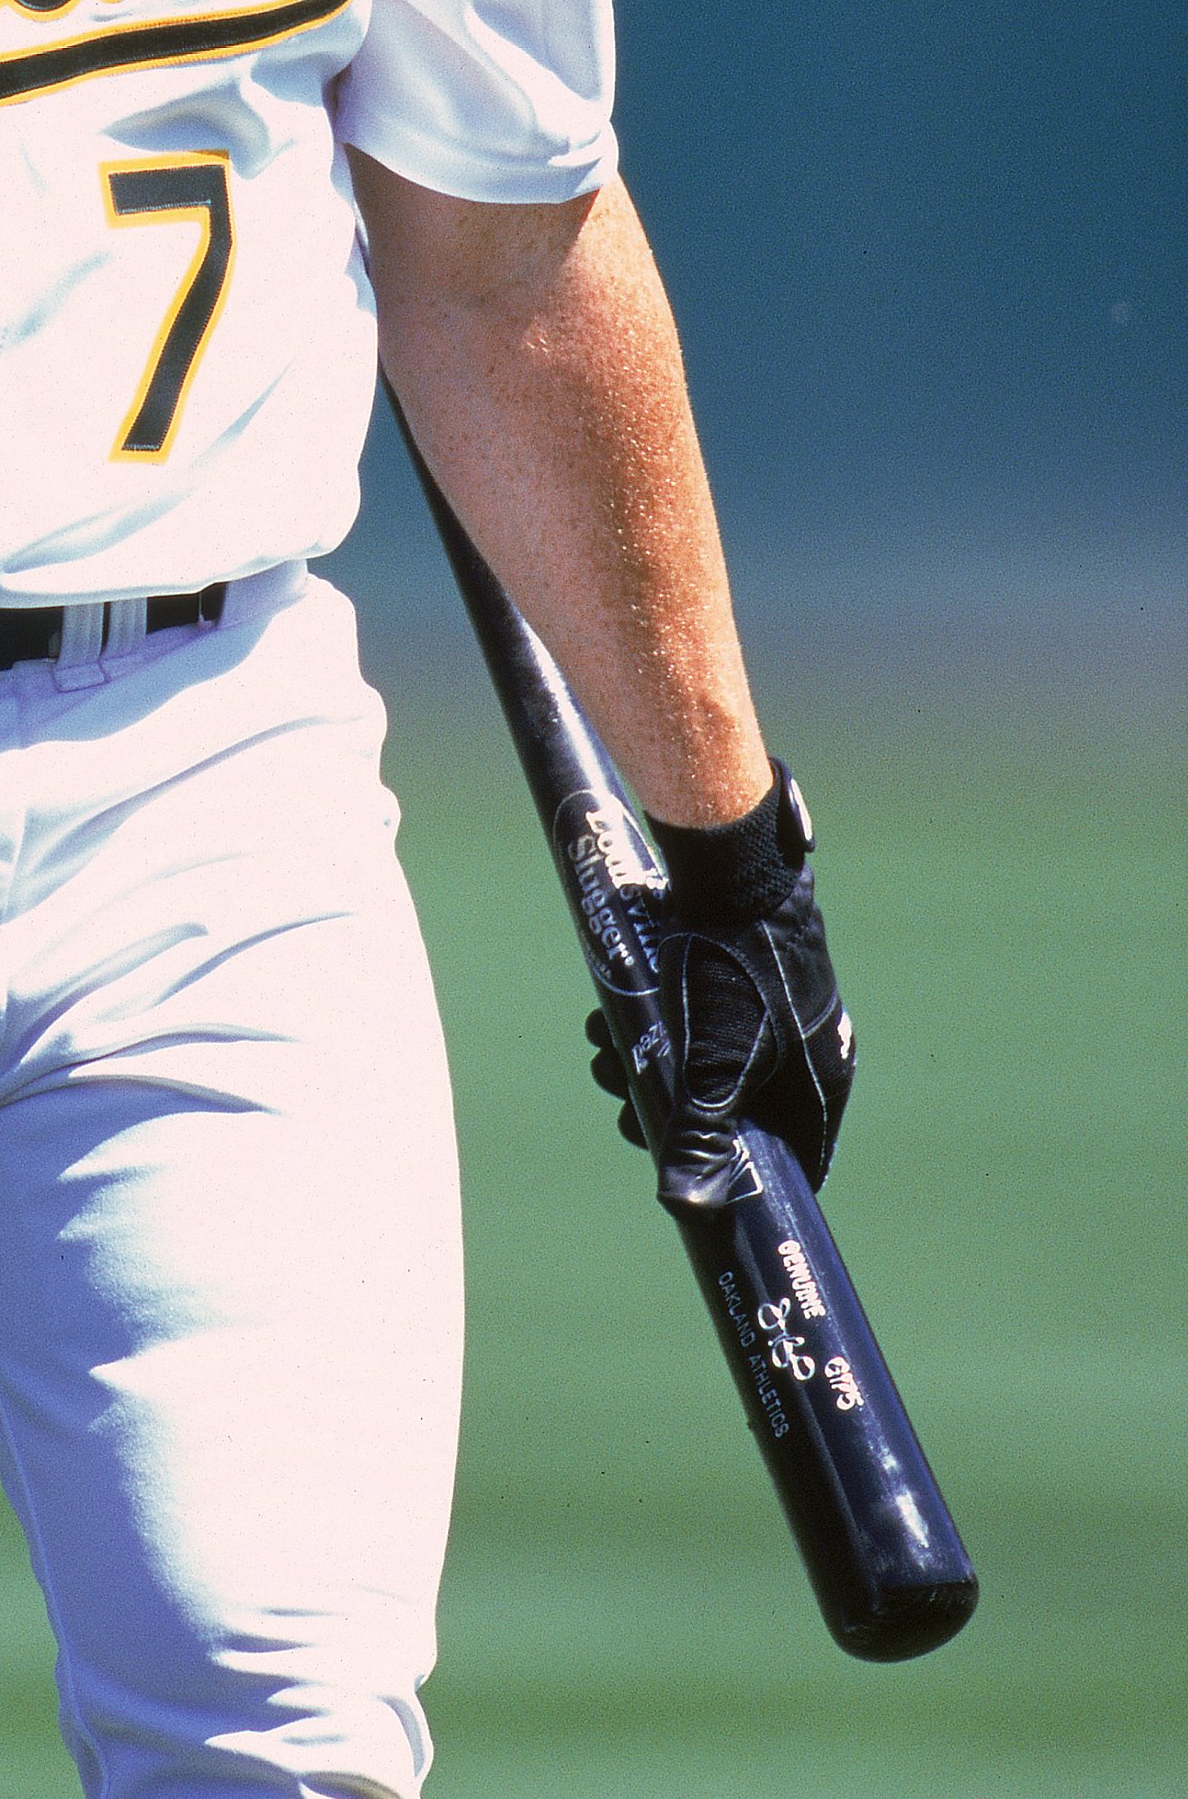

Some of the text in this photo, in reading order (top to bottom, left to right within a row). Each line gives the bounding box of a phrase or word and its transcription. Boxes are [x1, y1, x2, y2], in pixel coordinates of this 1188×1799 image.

[99, 149, 233, 463] 7
[568, 833, 626, 960] Slugger
[777, 1239, 826, 1320] GENUINE
[717, 1270, 757, 1348] OAKLAND
[748, 1352, 791, 1439] ATHLETICS
